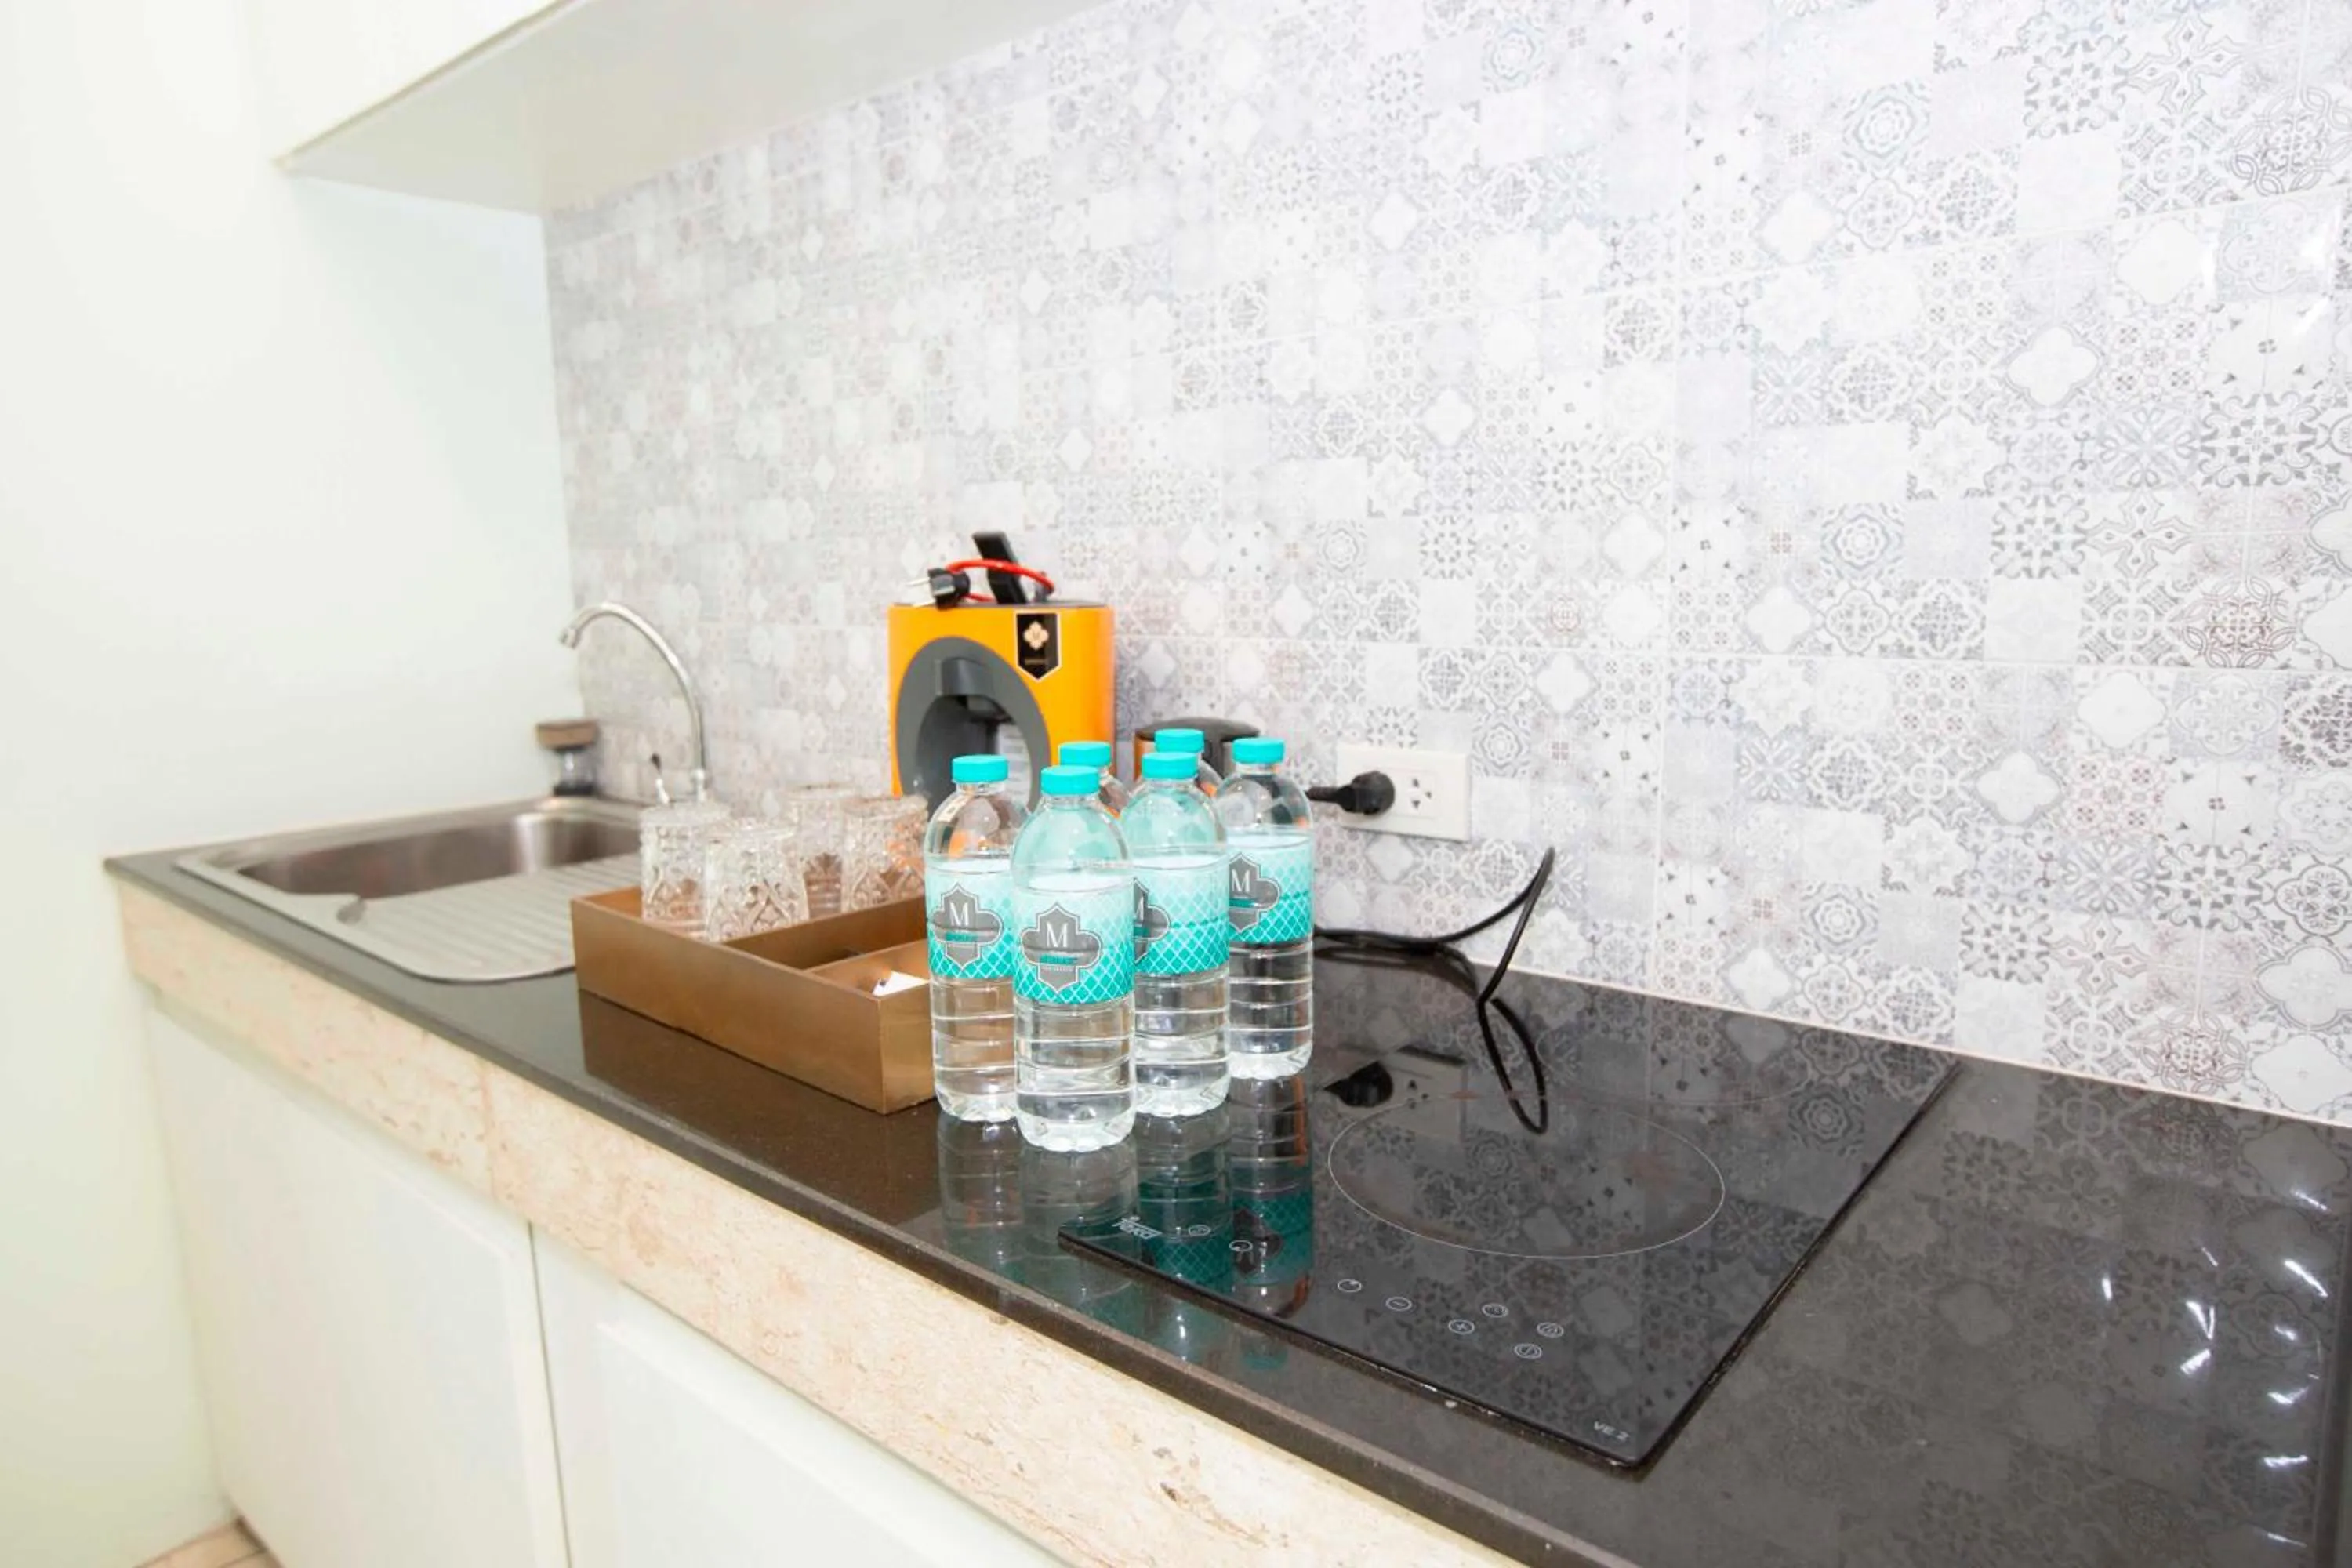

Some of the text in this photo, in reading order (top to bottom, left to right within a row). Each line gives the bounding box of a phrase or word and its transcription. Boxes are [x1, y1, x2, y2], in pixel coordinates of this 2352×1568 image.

[1232, 869, 1250, 892] M
[949, 902, 970, 927] M
[1046, 922, 1069, 948] M
